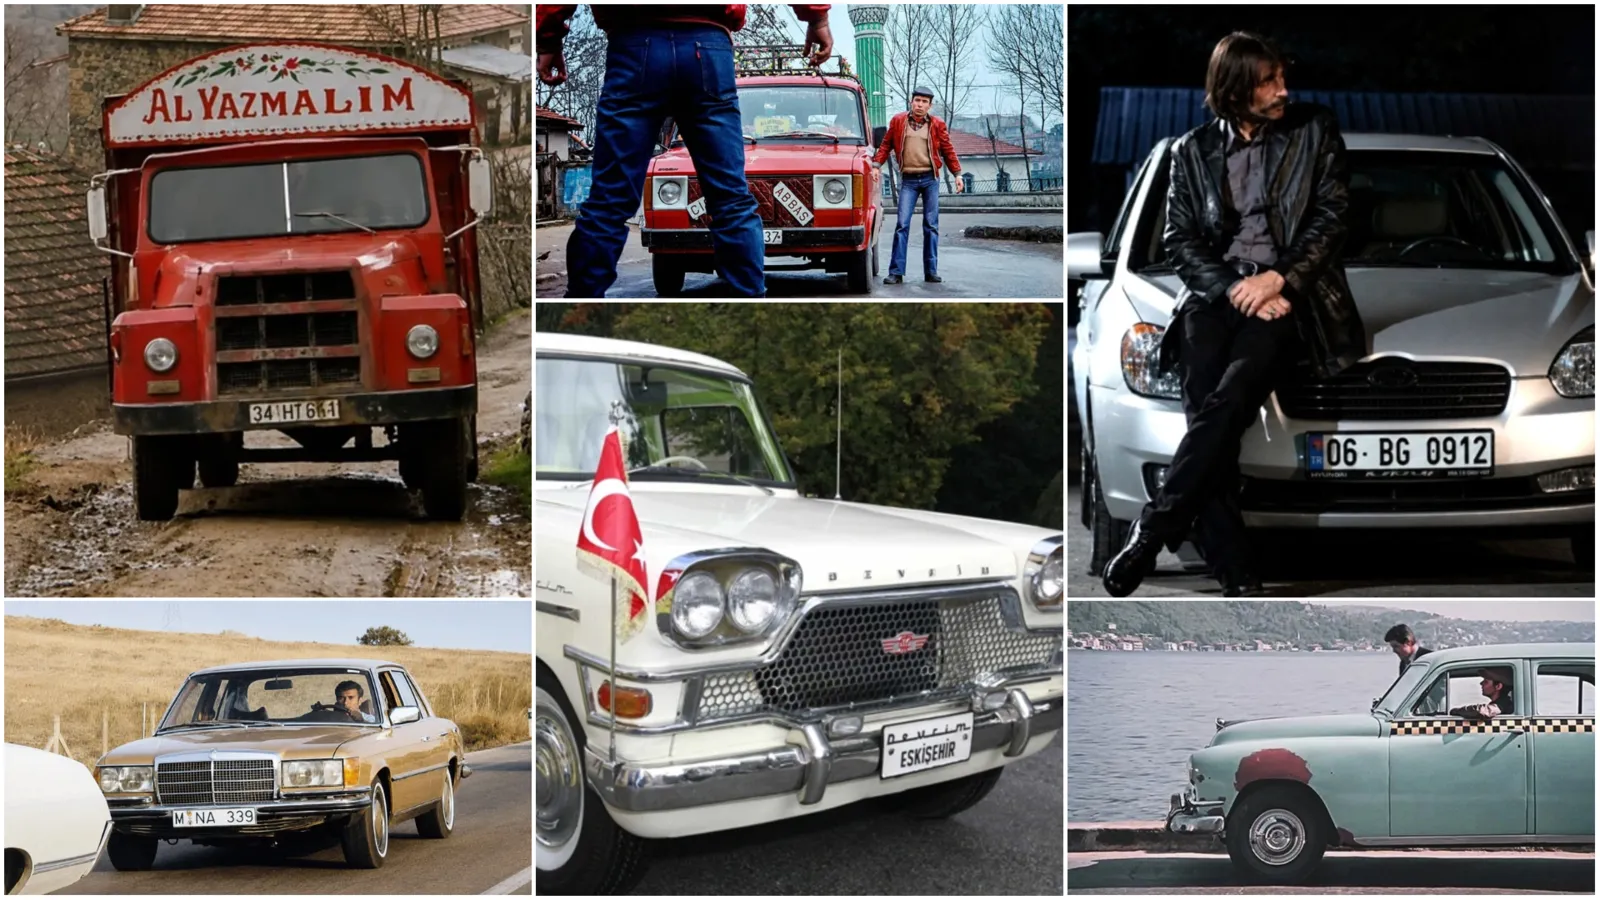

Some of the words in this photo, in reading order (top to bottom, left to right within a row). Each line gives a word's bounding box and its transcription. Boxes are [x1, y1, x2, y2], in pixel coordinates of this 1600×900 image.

[142, 87, 193, 125] AL
[197, 77, 415, 121] YAZMALIM
[774, 186, 809, 222] ABBAS
[252, 404, 273, 422] 34
[282, 403, 302, 420] HT
[1310, 455, 1323, 465] TR
[1379, 437, 1410, 467] BG
[1426, 435, 1488, 466] 0912
[1311, 471, 1348, 479] HYUNDAI
[886, 722, 971, 746] Devrim
[900, 738, 957, 768] ESKİŞEHİR
[174, 812, 184, 825] M
[195, 811, 216, 824] NA
[226, 810, 254, 823] 339
